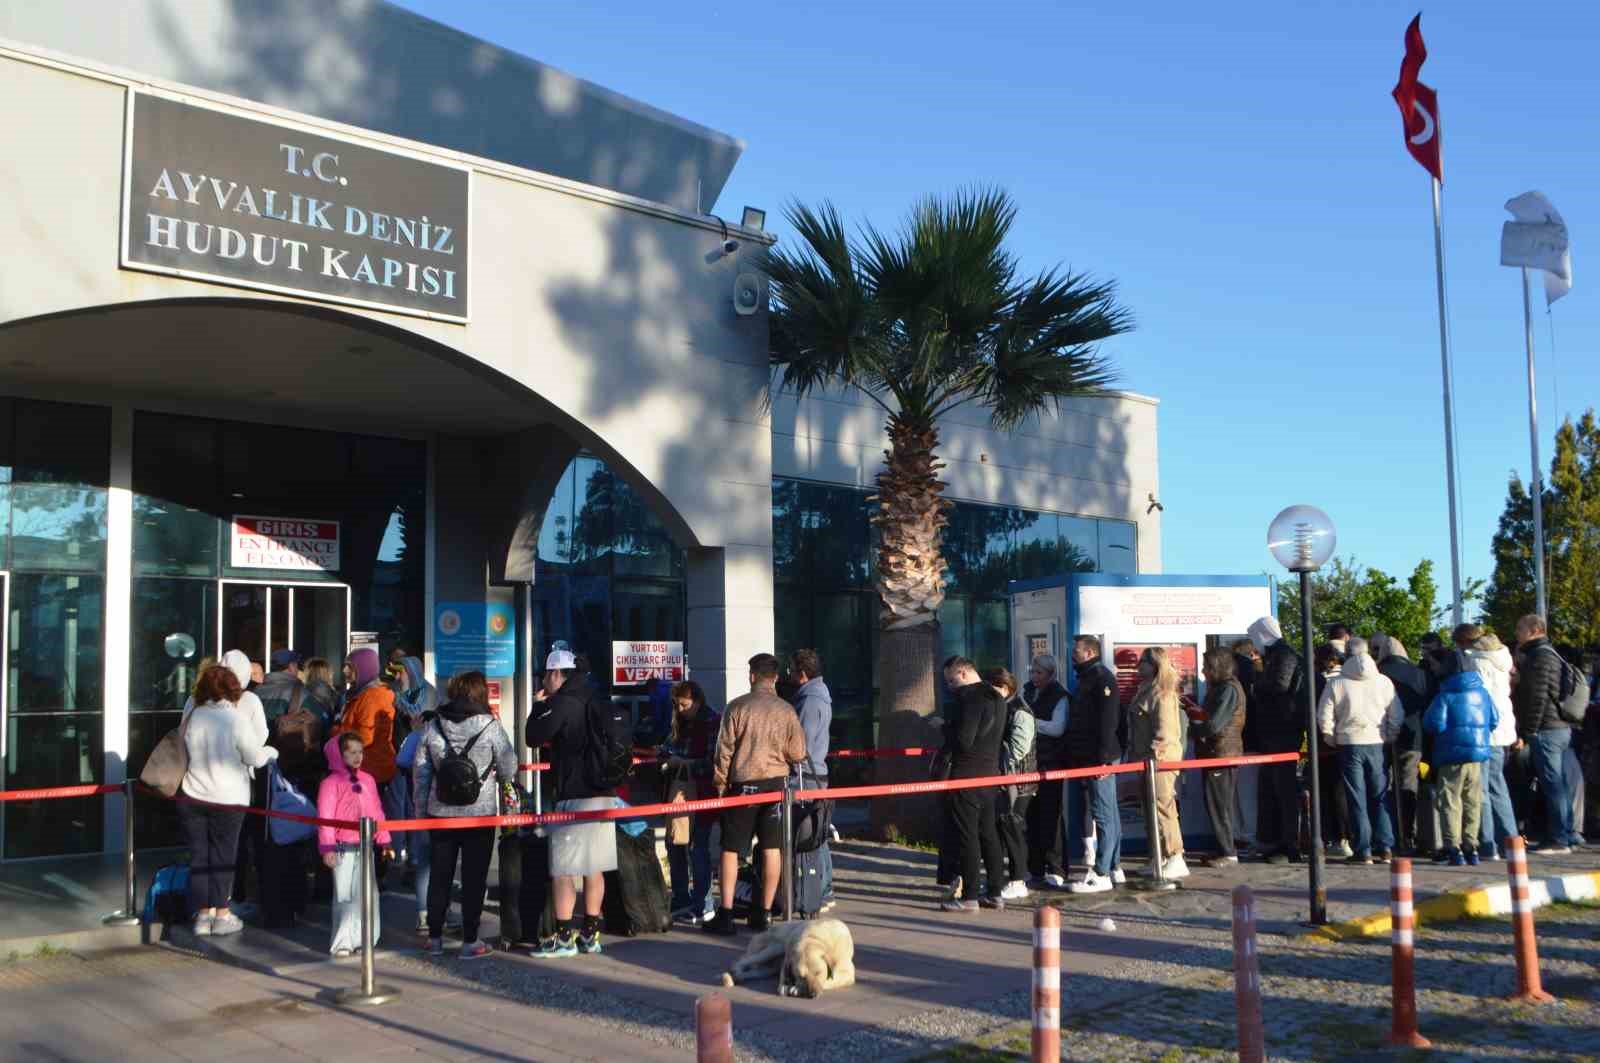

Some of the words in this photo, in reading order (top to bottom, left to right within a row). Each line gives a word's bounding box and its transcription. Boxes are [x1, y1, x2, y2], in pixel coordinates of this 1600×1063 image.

[279, 143, 349, 187] T.C.
[149, 167, 335, 232] AYVALIK
[343, 205, 455, 255] DENİZ
[146, 213, 309, 272] HUDUT
[319, 246, 457, 299] KAPISI
[239, 537, 337, 554] ENTRANCE
[631, 643, 650, 653] YURT
[661, 655, 681, 665] PULU
[624, 667, 673, 681] VEZNE
